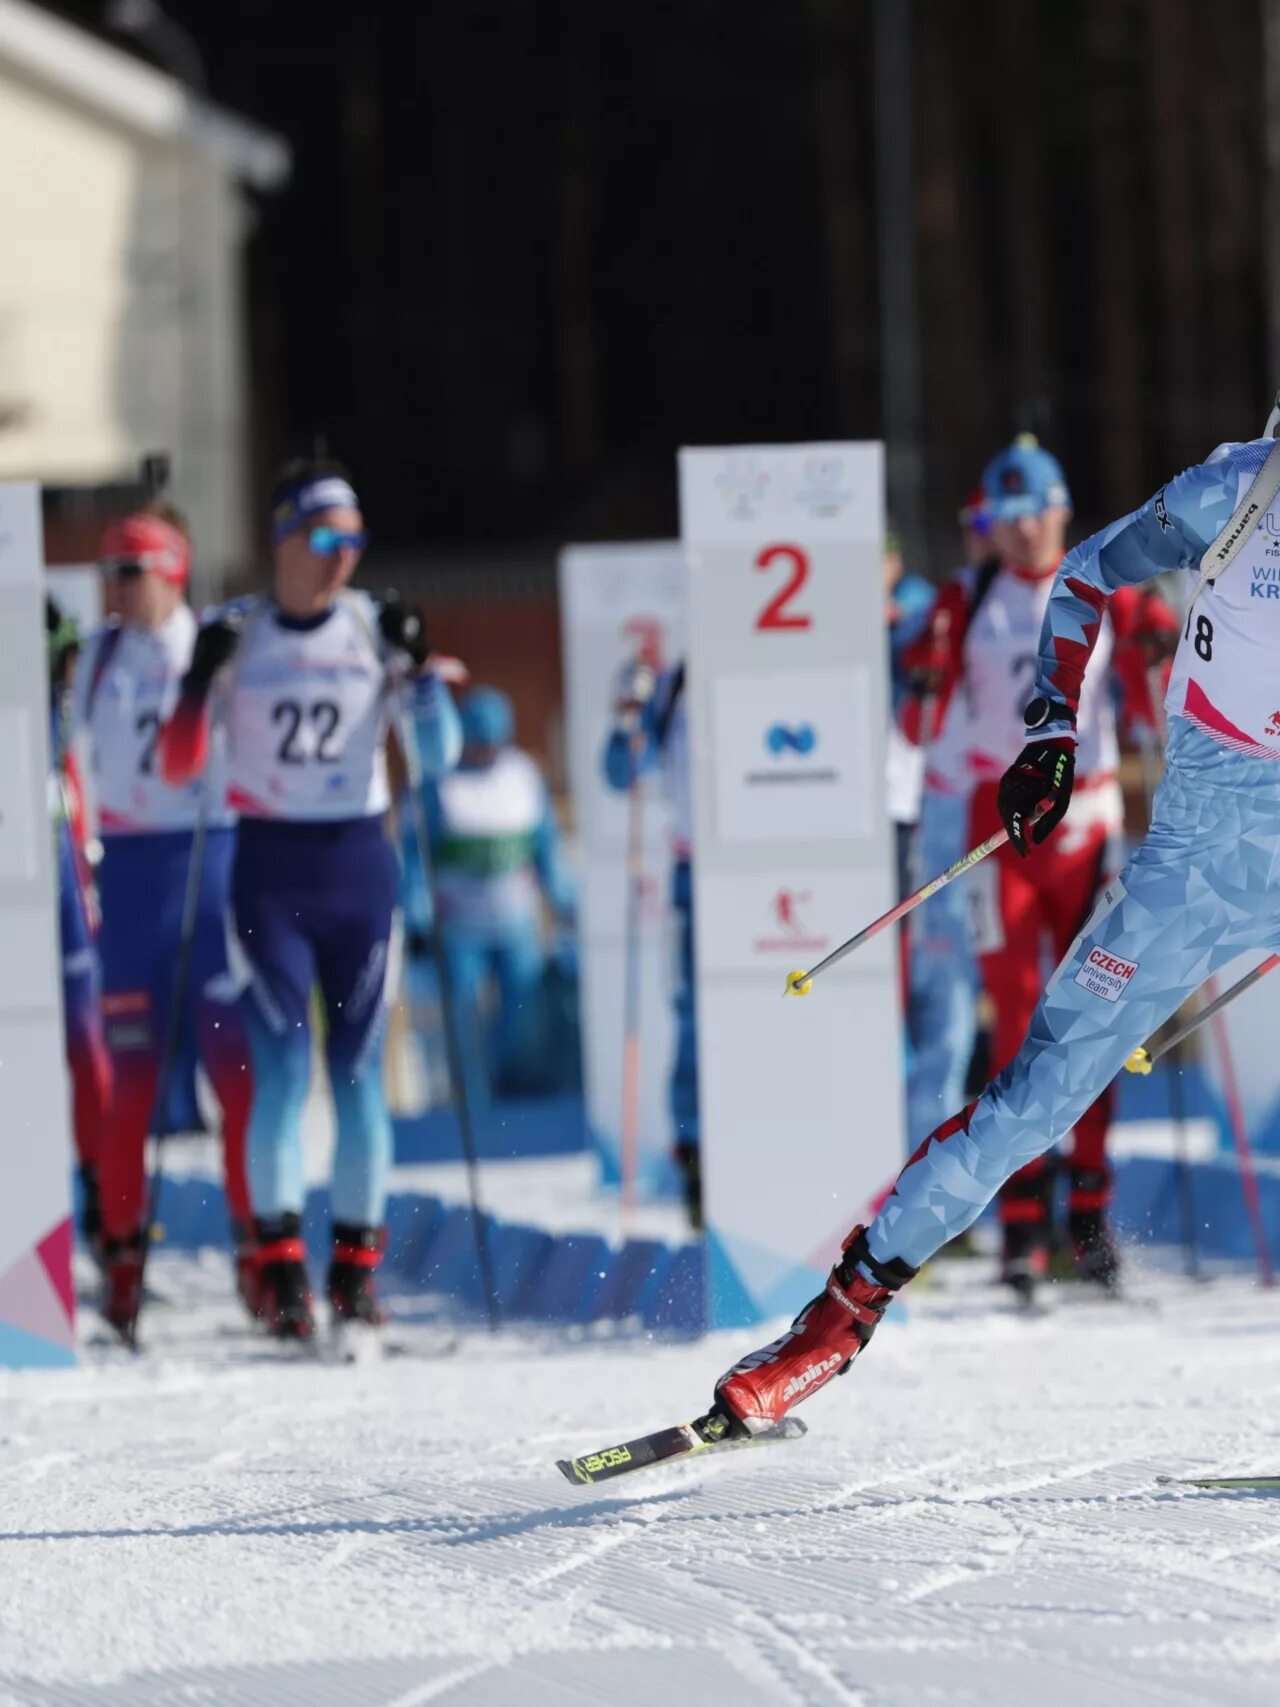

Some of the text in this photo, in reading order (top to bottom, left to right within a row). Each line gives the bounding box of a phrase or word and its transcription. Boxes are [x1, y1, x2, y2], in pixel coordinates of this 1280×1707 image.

[1217, 503, 1259, 560] barnett
[754, 541, 814, 632] 2
[271, 701, 343, 765] 22
[1053, 753, 1068, 788] LEKI
[1082, 964, 1125, 991] university
[1089, 950, 1135, 979] CZECH
[1085, 978, 1109, 997] team
[831, 1285, 861, 1315] alpina
[783, 1352, 843, 1402] alpina
[583, 1445, 633, 1473] FISCHER
